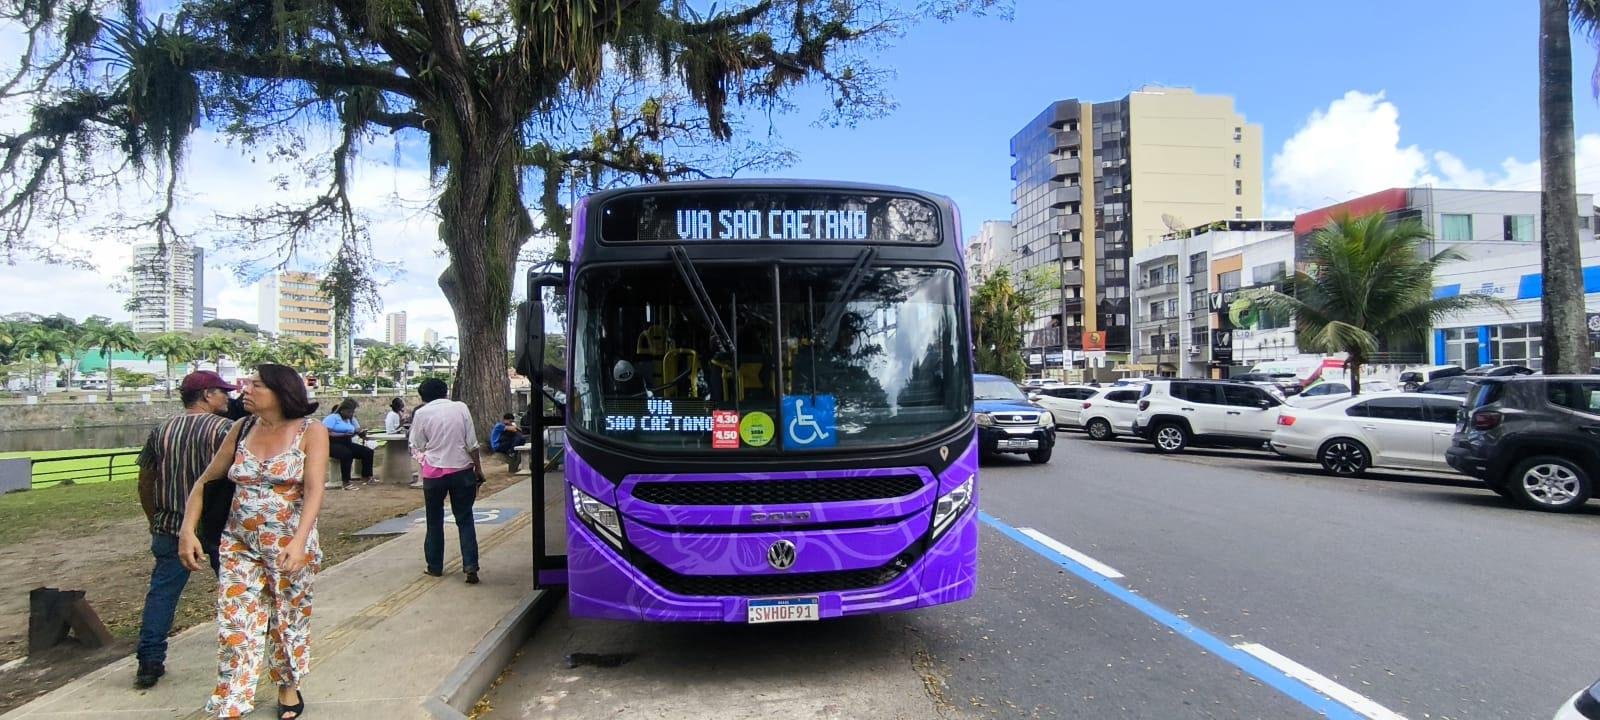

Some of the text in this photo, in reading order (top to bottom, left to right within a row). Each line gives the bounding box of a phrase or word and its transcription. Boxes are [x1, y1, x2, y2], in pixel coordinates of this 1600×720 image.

[677, 210, 867, 239] VIA SAO CAETANO
[647, 399, 672, 415] VIA
[605, 415, 714, 431] SAO CAETANO
